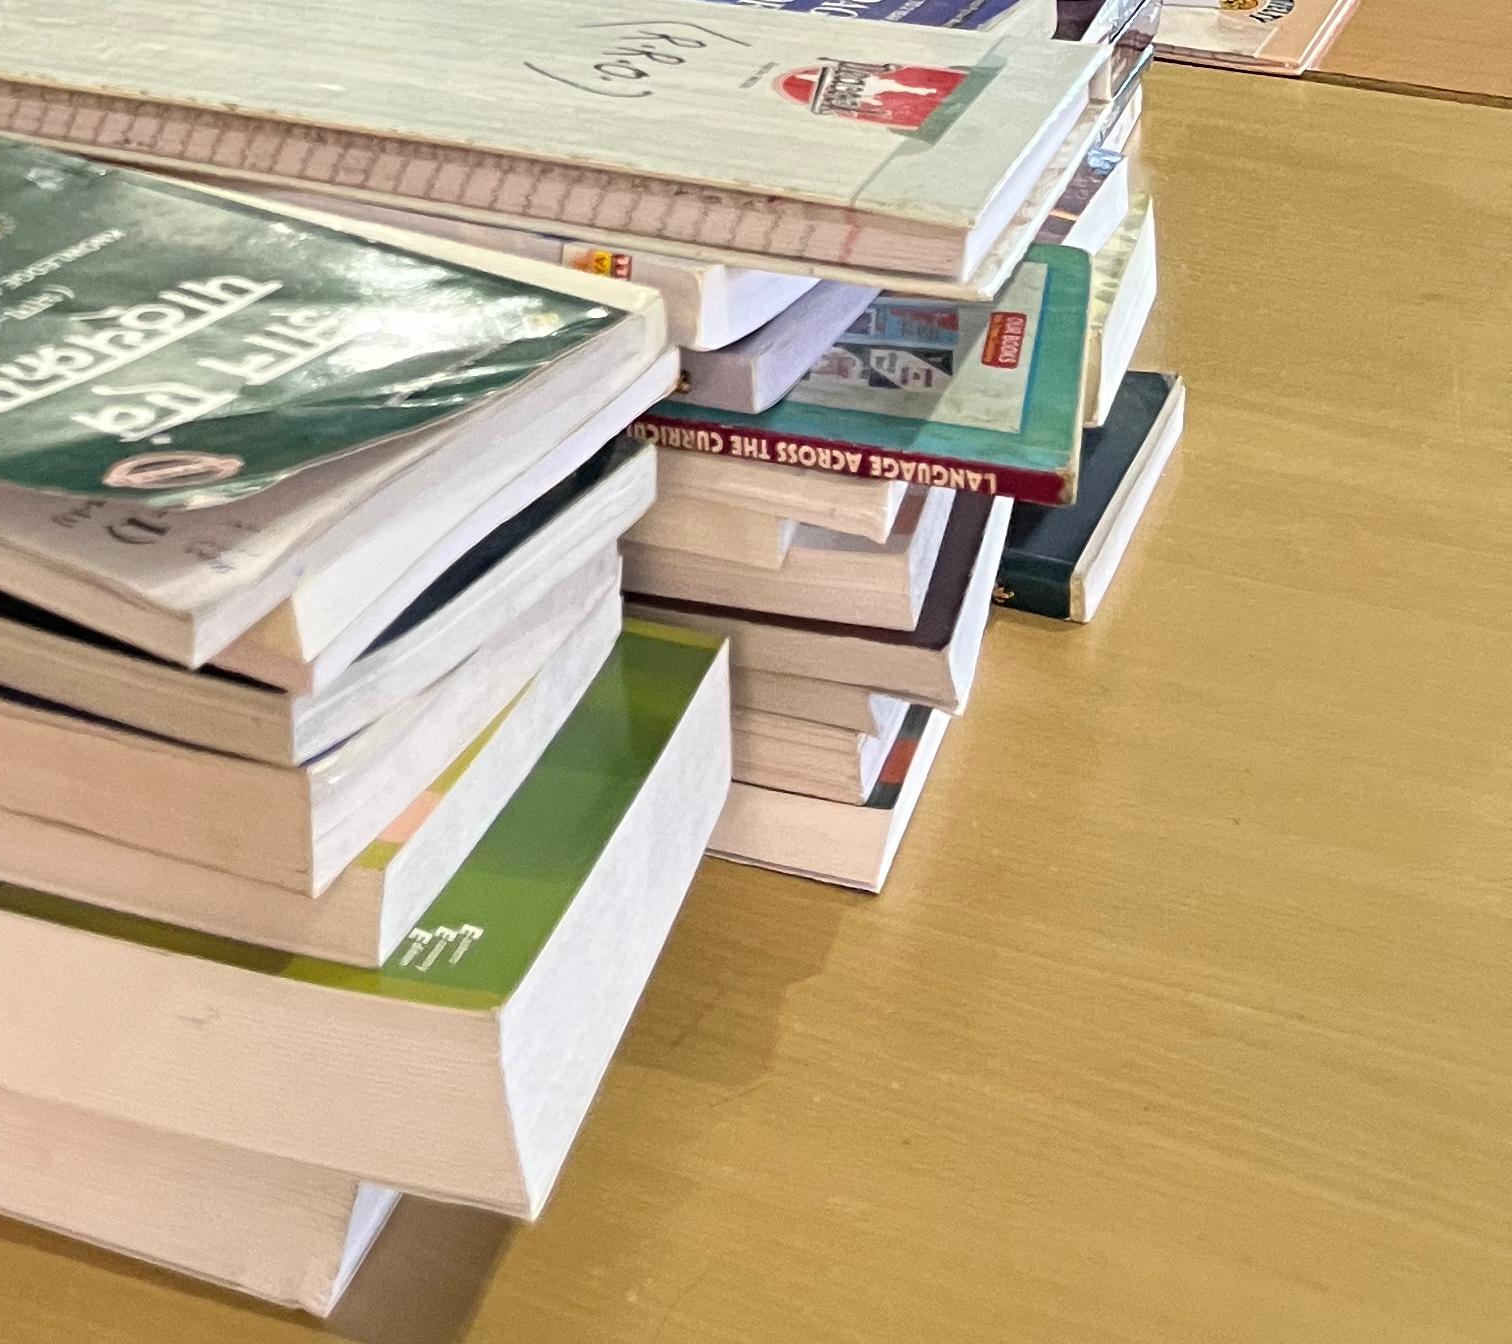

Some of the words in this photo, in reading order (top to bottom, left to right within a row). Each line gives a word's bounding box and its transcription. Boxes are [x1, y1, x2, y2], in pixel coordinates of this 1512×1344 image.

[0, 229, 126, 289] KNOWLEDGE
[70, 383, 238, 445] एवं
[729, 435, 771, 460] THE
[776, 441, 862, 474] ACROSS
[869, 454, 997, 494] LANGUAGE
